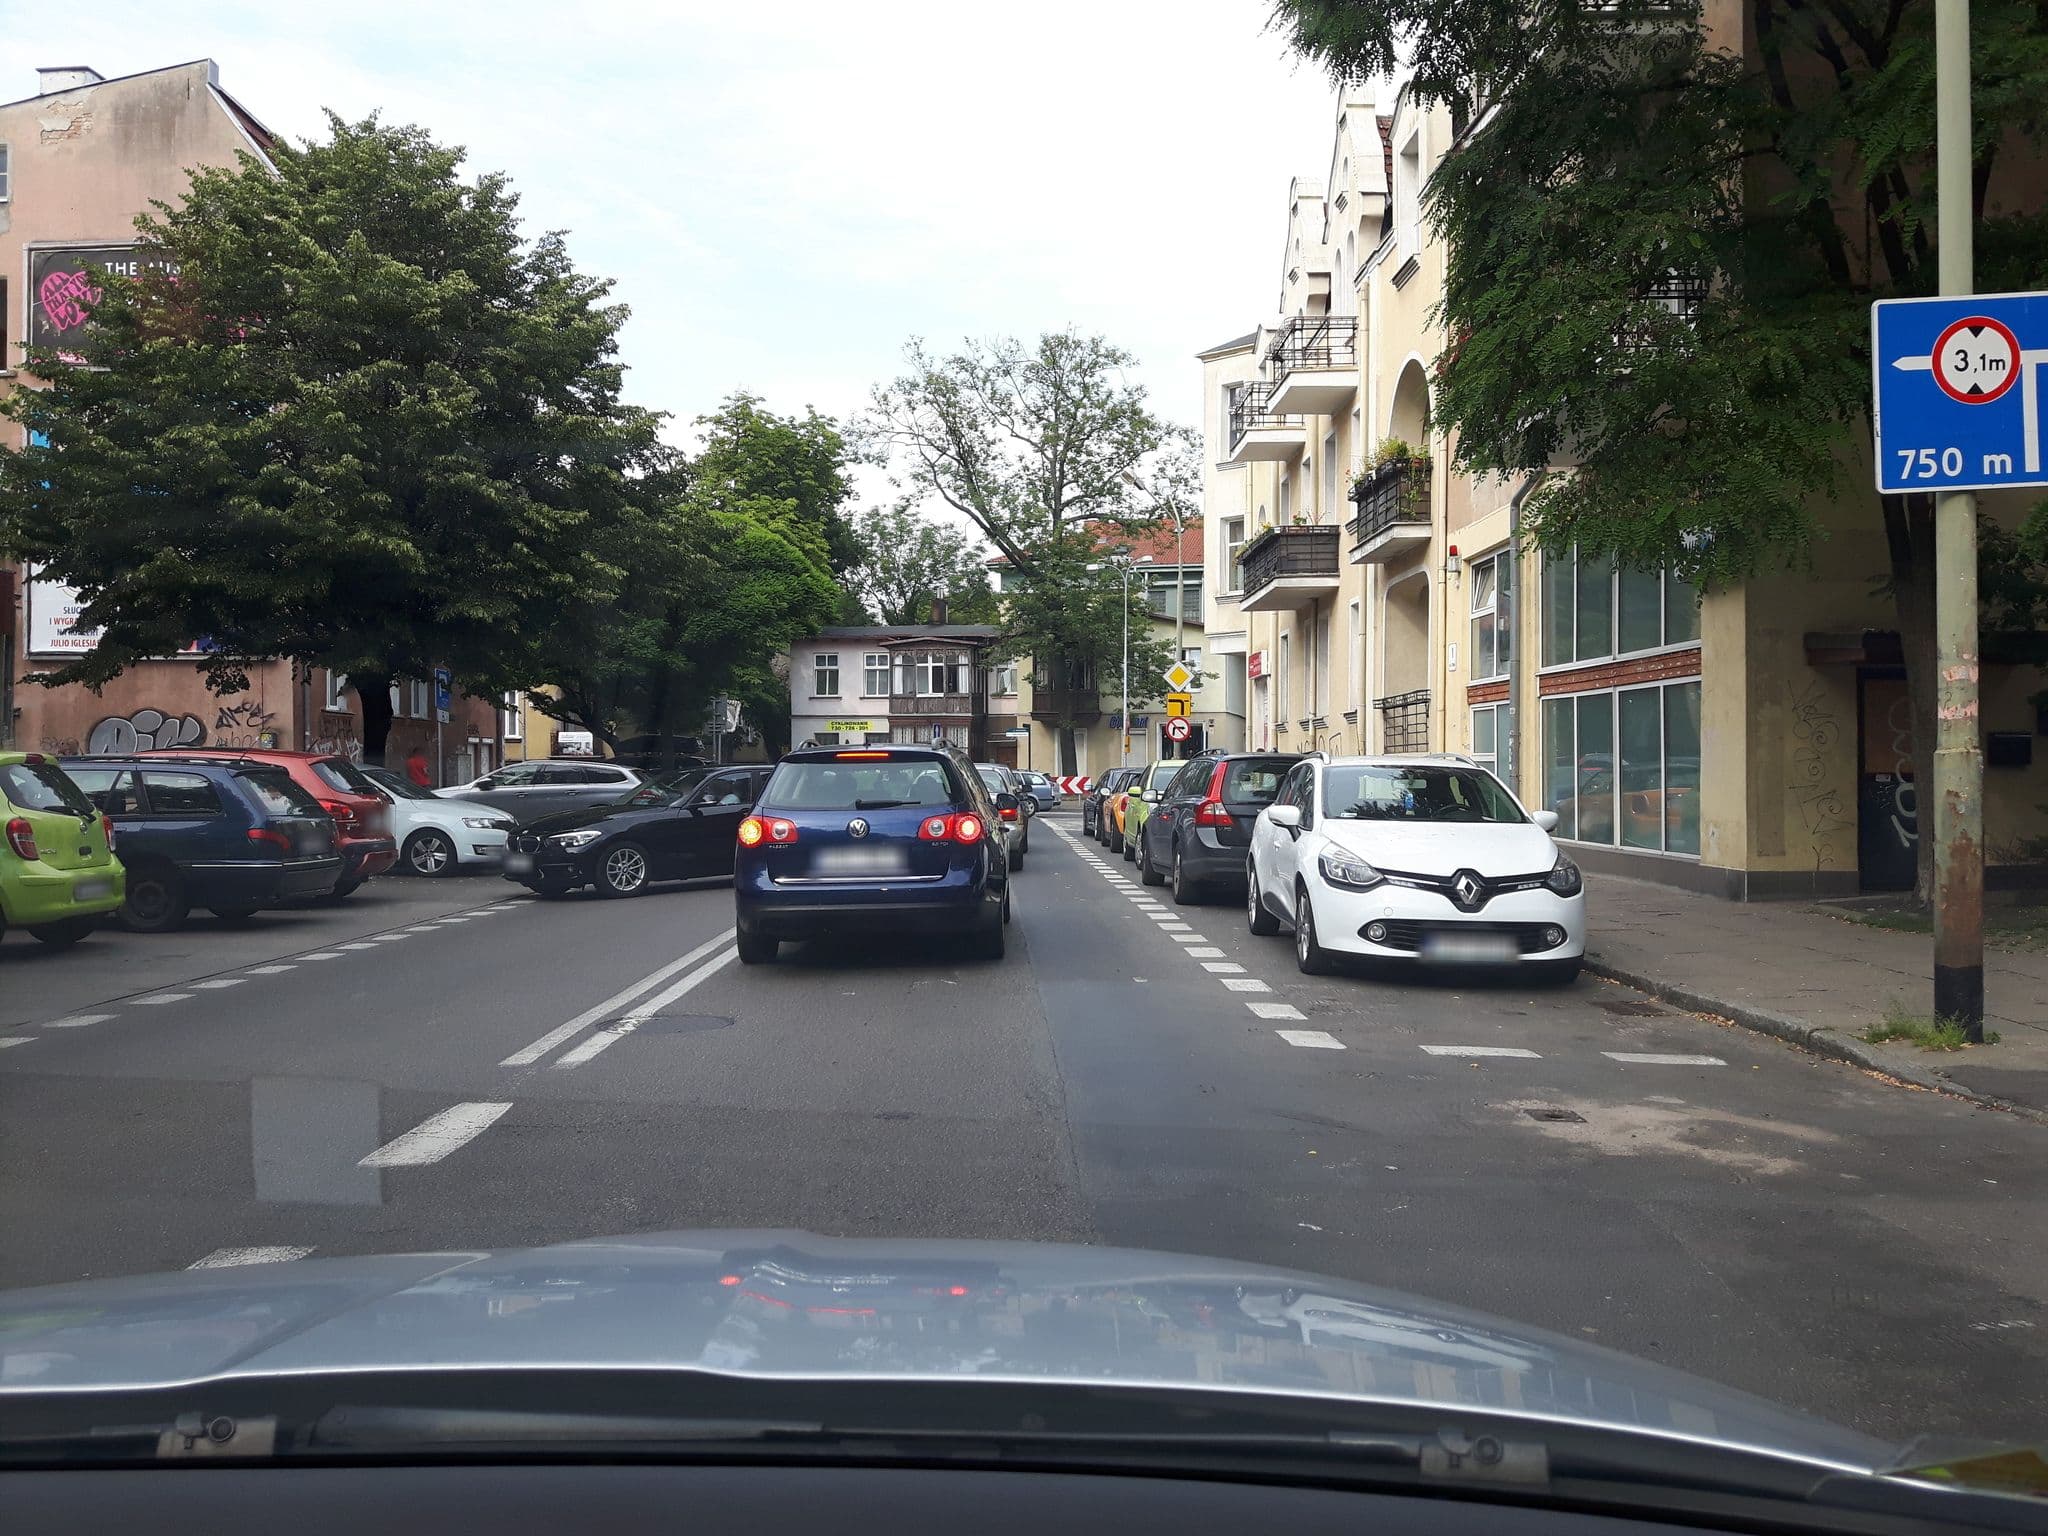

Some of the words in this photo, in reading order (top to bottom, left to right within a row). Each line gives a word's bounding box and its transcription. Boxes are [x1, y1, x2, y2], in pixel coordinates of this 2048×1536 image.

[104, 261, 138, 276] THE
[44, 274, 70, 301] ALL
[1897, 447, 1963, 480] 750
[1983, 452, 2012, 475] m
[50, 639, 70, 647] JULIO
[71, 639, 98, 647] IGLESIA
